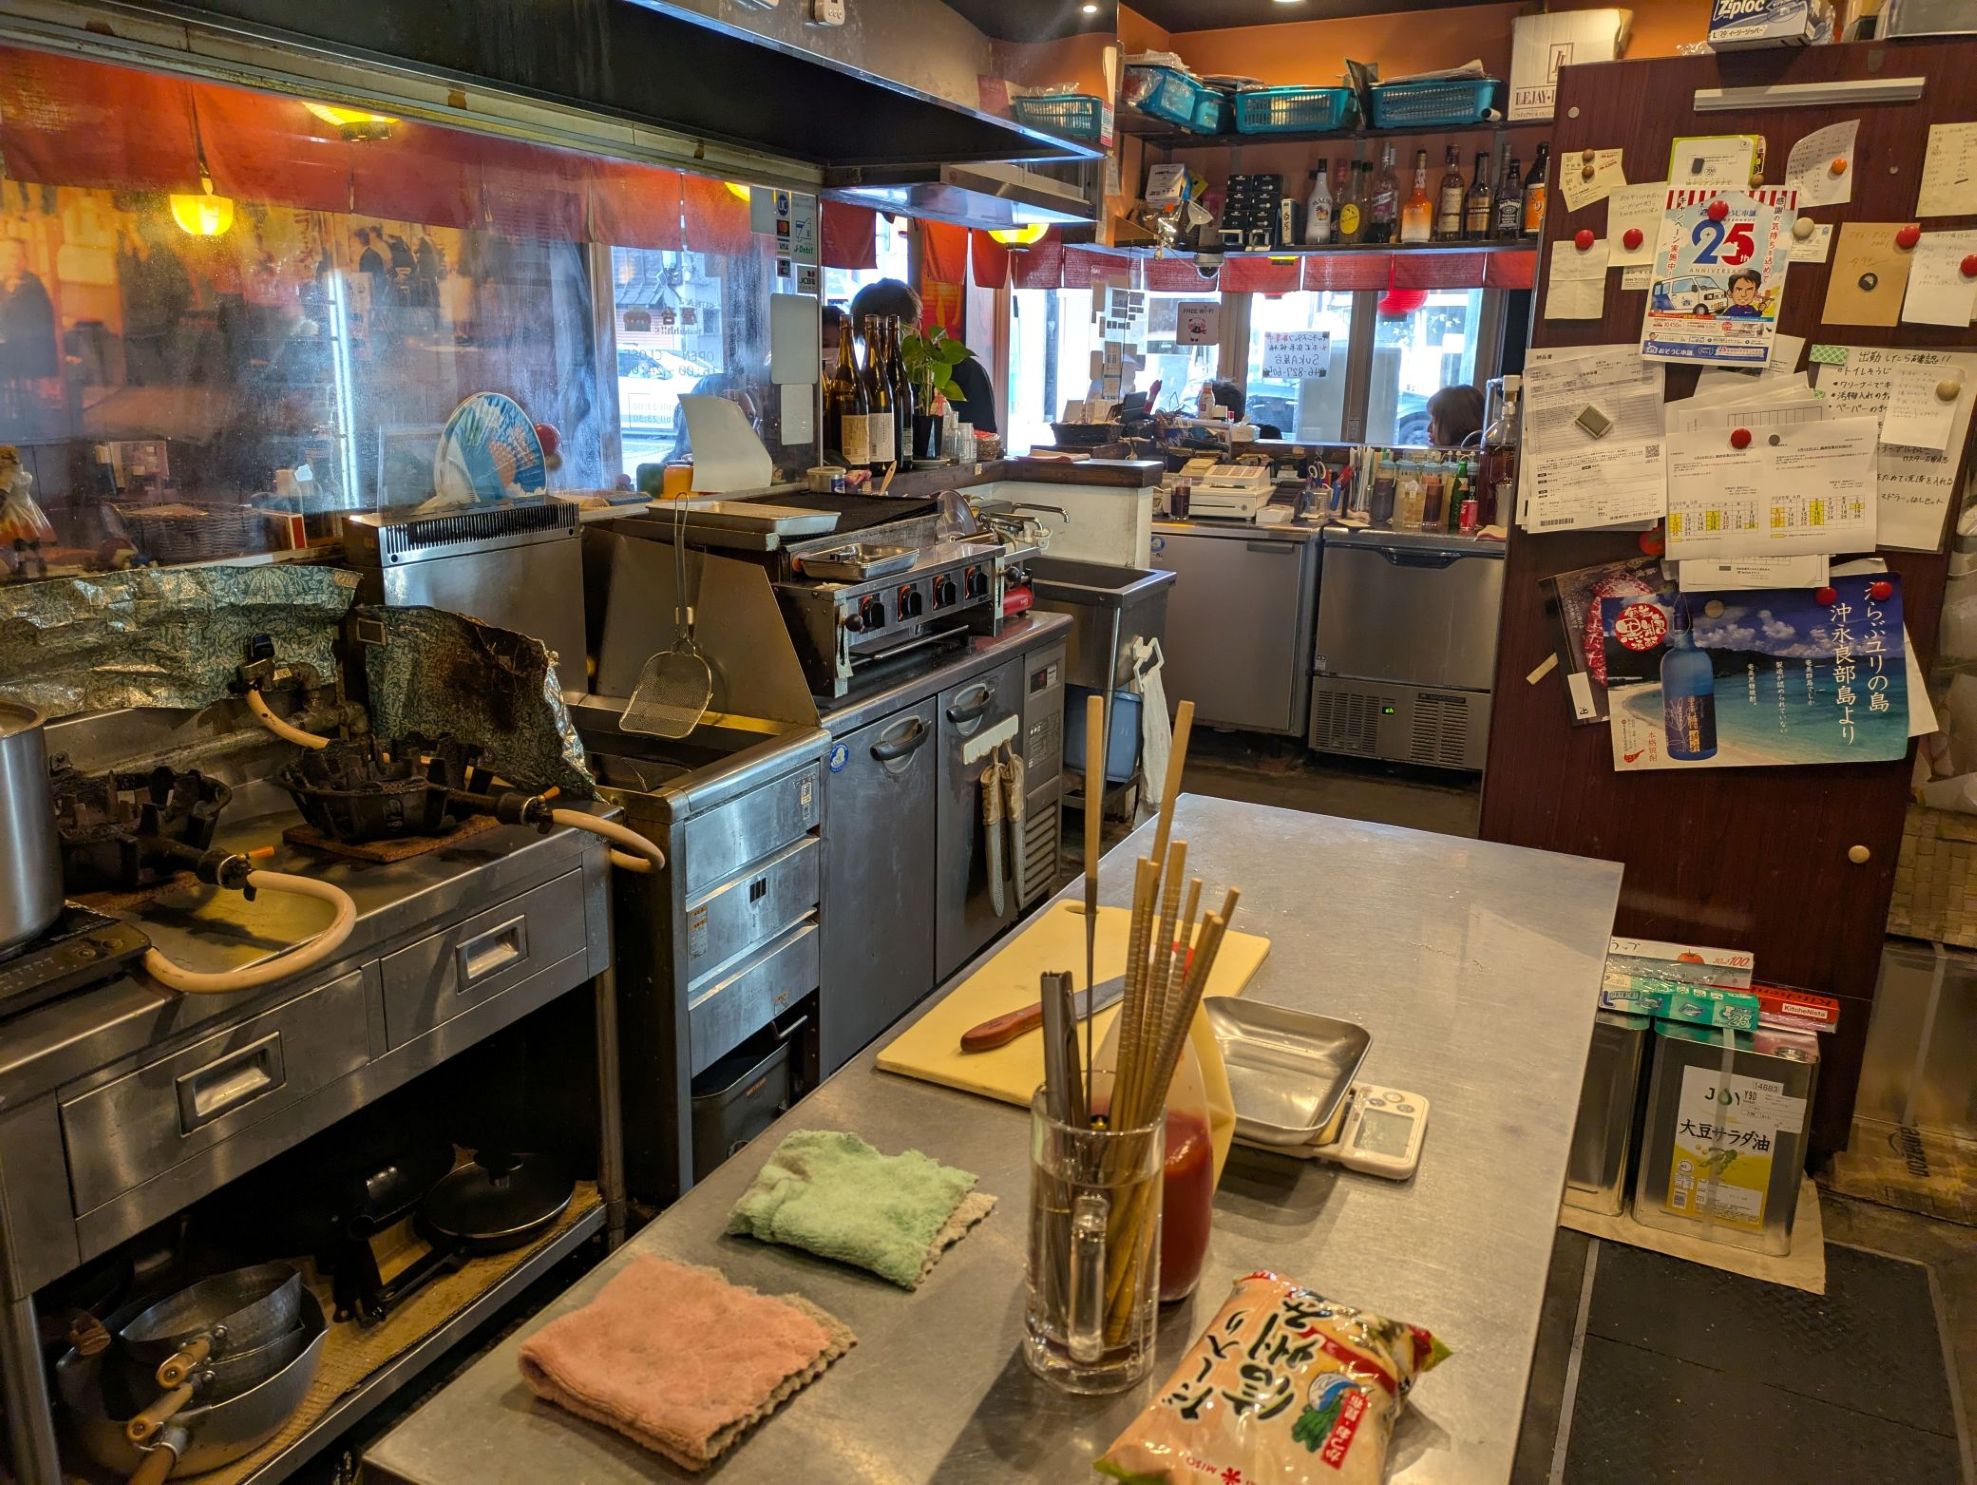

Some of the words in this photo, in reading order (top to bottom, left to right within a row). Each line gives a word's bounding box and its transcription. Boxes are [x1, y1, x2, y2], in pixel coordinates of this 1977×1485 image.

[1718, 0, 1765, 19] Ziploc
[1692, 219, 1755, 265] 25
[1830, 603, 1856, 745] 沖永良部島より
[1784, 1006, 1826, 1017] KitcheNista
[1680, 1118, 1770, 1152] 大豆サラダ油
[1900, 1126, 1930, 1177] amazon
